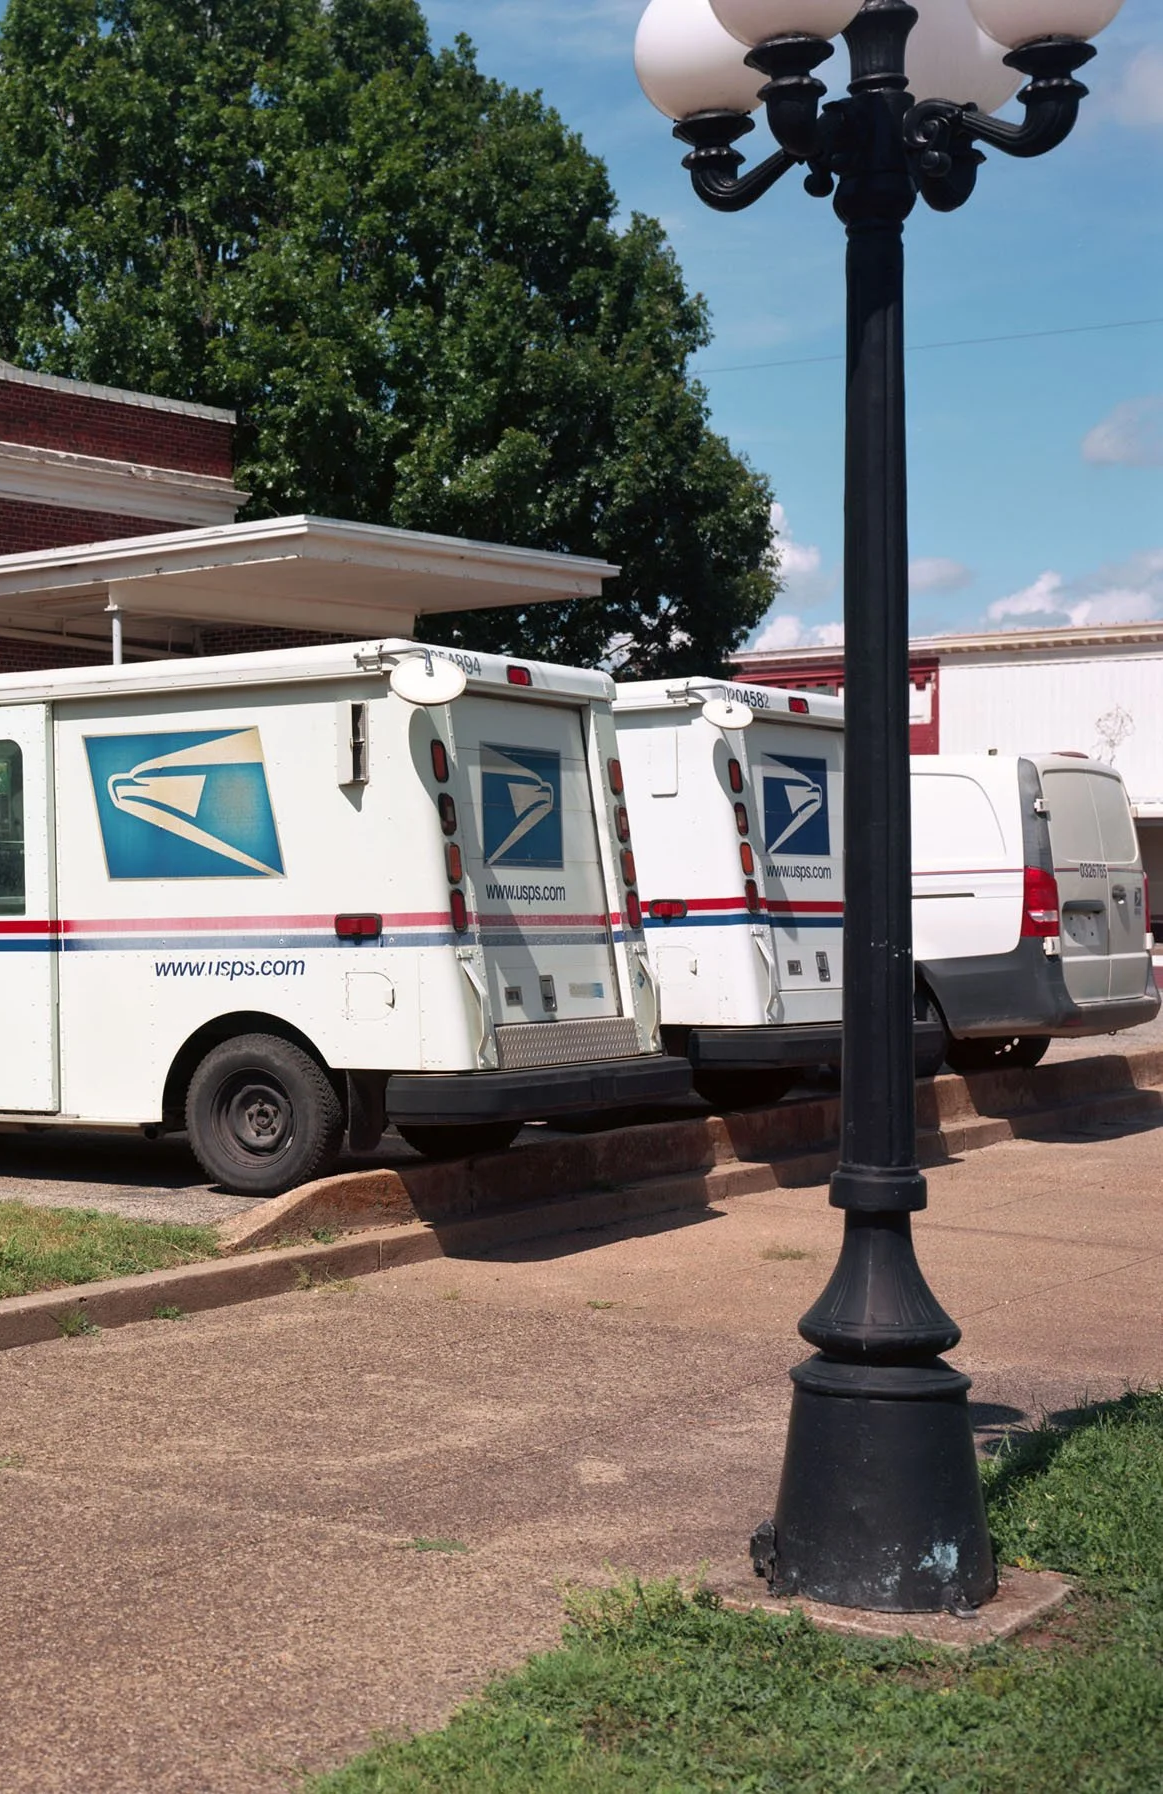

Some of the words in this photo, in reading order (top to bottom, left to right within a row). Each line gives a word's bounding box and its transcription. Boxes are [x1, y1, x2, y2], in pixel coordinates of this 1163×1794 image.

[765, 865, 832, 881] www.usps.com
[485, 884, 566, 905] www.usps.com
[155, 959, 306, 981] www.usps.com
